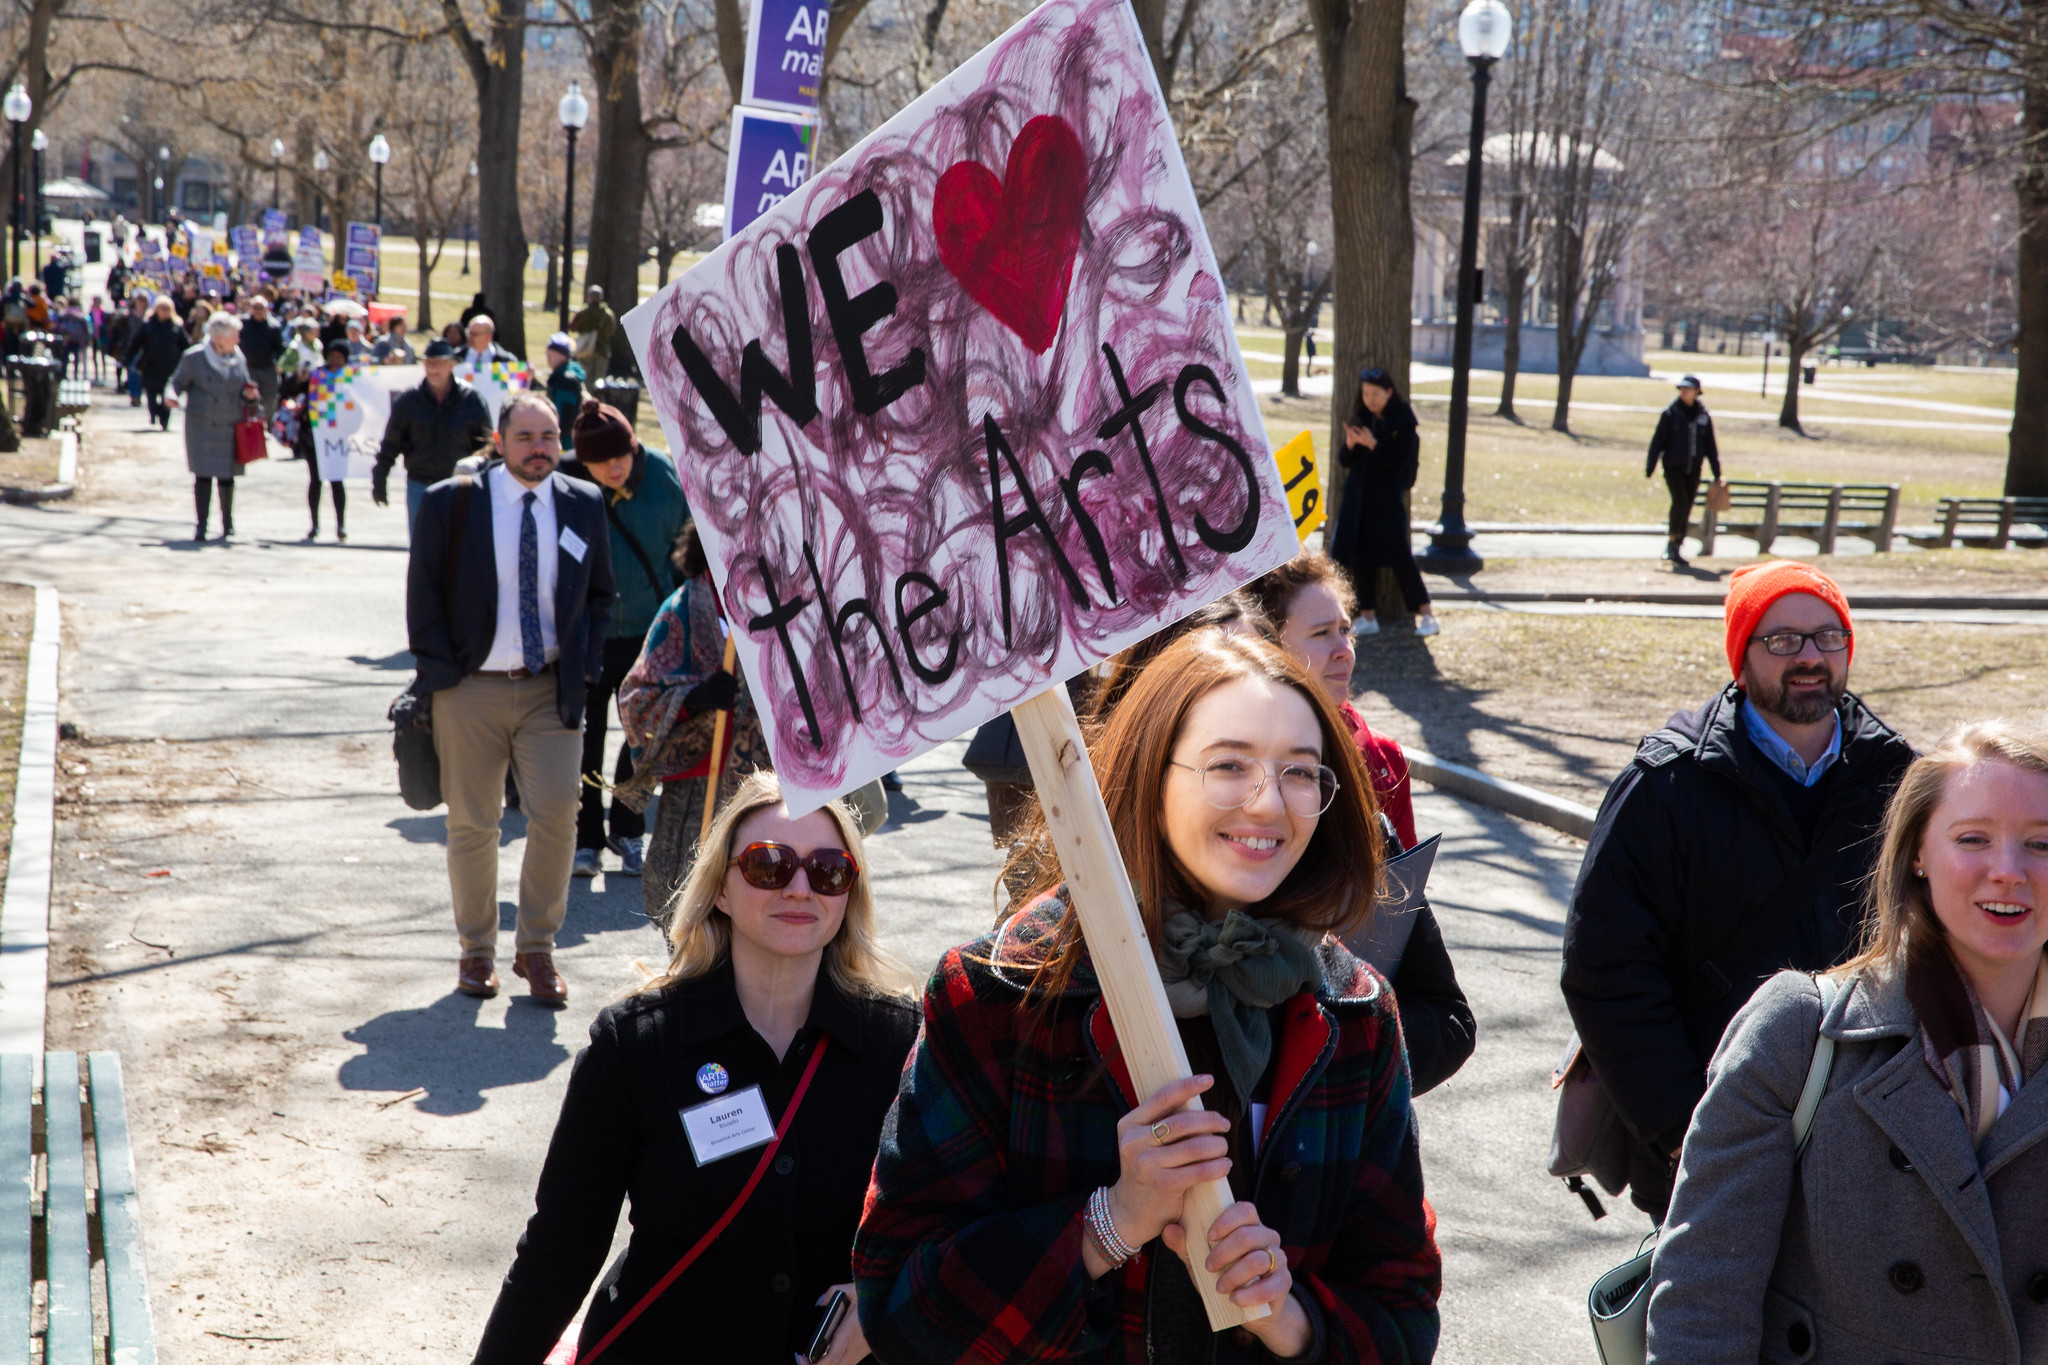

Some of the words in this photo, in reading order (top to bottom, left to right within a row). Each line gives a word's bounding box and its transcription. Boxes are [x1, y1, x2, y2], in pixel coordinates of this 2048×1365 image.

[672, 188, 925, 455] WE
[748, 541, 960, 747] the
[985, 342, 1260, 650] Arts
[703, 1071, 727, 1082] ARTS
[710, 1108, 743, 1124] Lauren
